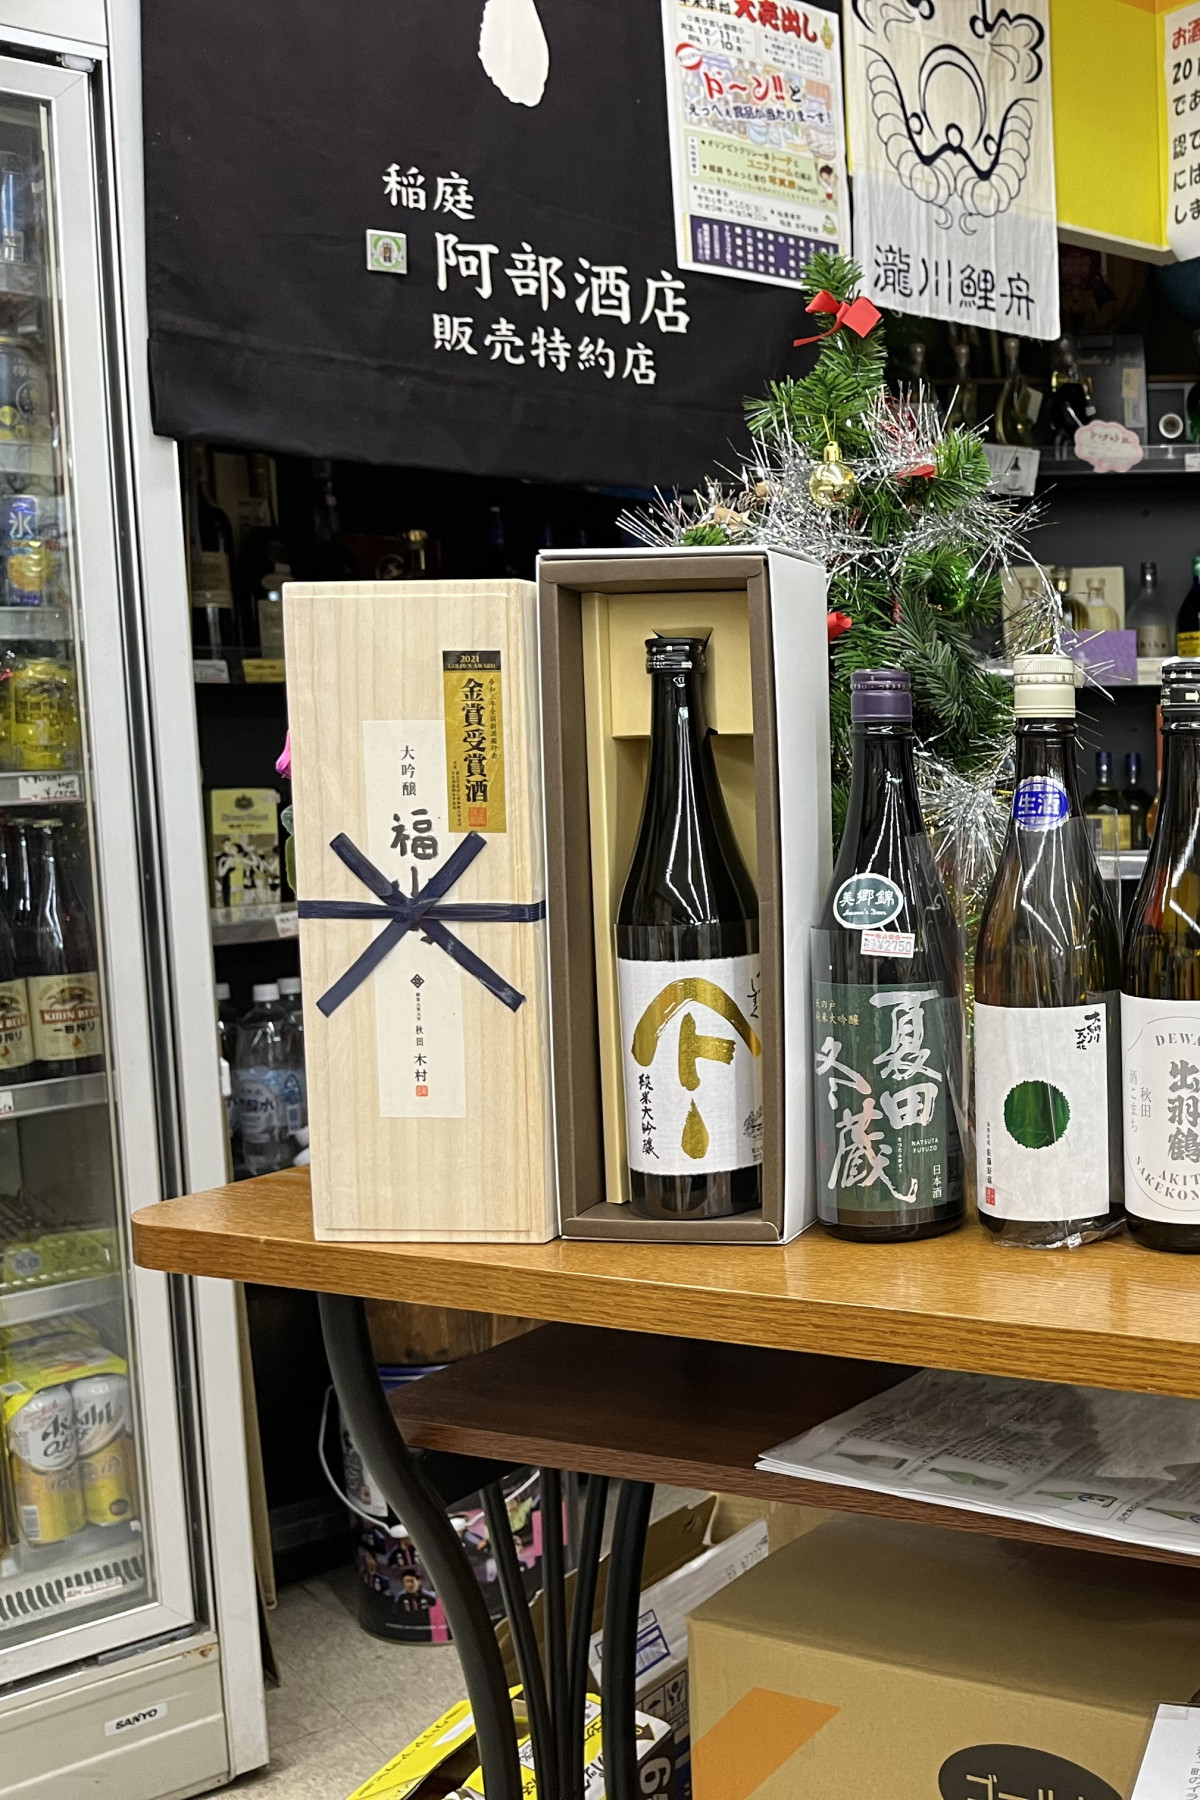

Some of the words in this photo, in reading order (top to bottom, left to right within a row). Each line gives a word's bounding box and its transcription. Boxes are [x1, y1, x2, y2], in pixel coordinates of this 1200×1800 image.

[381, 161, 477, 222] 稲庭
[433, 230, 693, 336] 阿部酒店
[873, 243, 1037, 322] 瀧川鯉舟
[432, 312, 658, 386] 販売特約店
[460, 655, 480, 663] 2021
[461, 677, 489, 803] 金賞受賞酒
[400, 745, 417, 797] 大吟醸
[1016, 790, 1062, 817] 生酒
[838, 888, 896, 907] 美郷錦
[44, 1009, 76, 1022] KIRIN
[415, 1025, 425, 1047] 秋田
[413, 1052, 428, 1083] 木村
[638, 1073, 660, 1160] 純米大吟醸
[1129, 1069, 1138, 1132] 酒こまち
[1140, 1086, 1152, 1119] 秋田
[932, 1164, 943, 1199] 日本酒
[115, 1708, 158, 1730] SANYO
